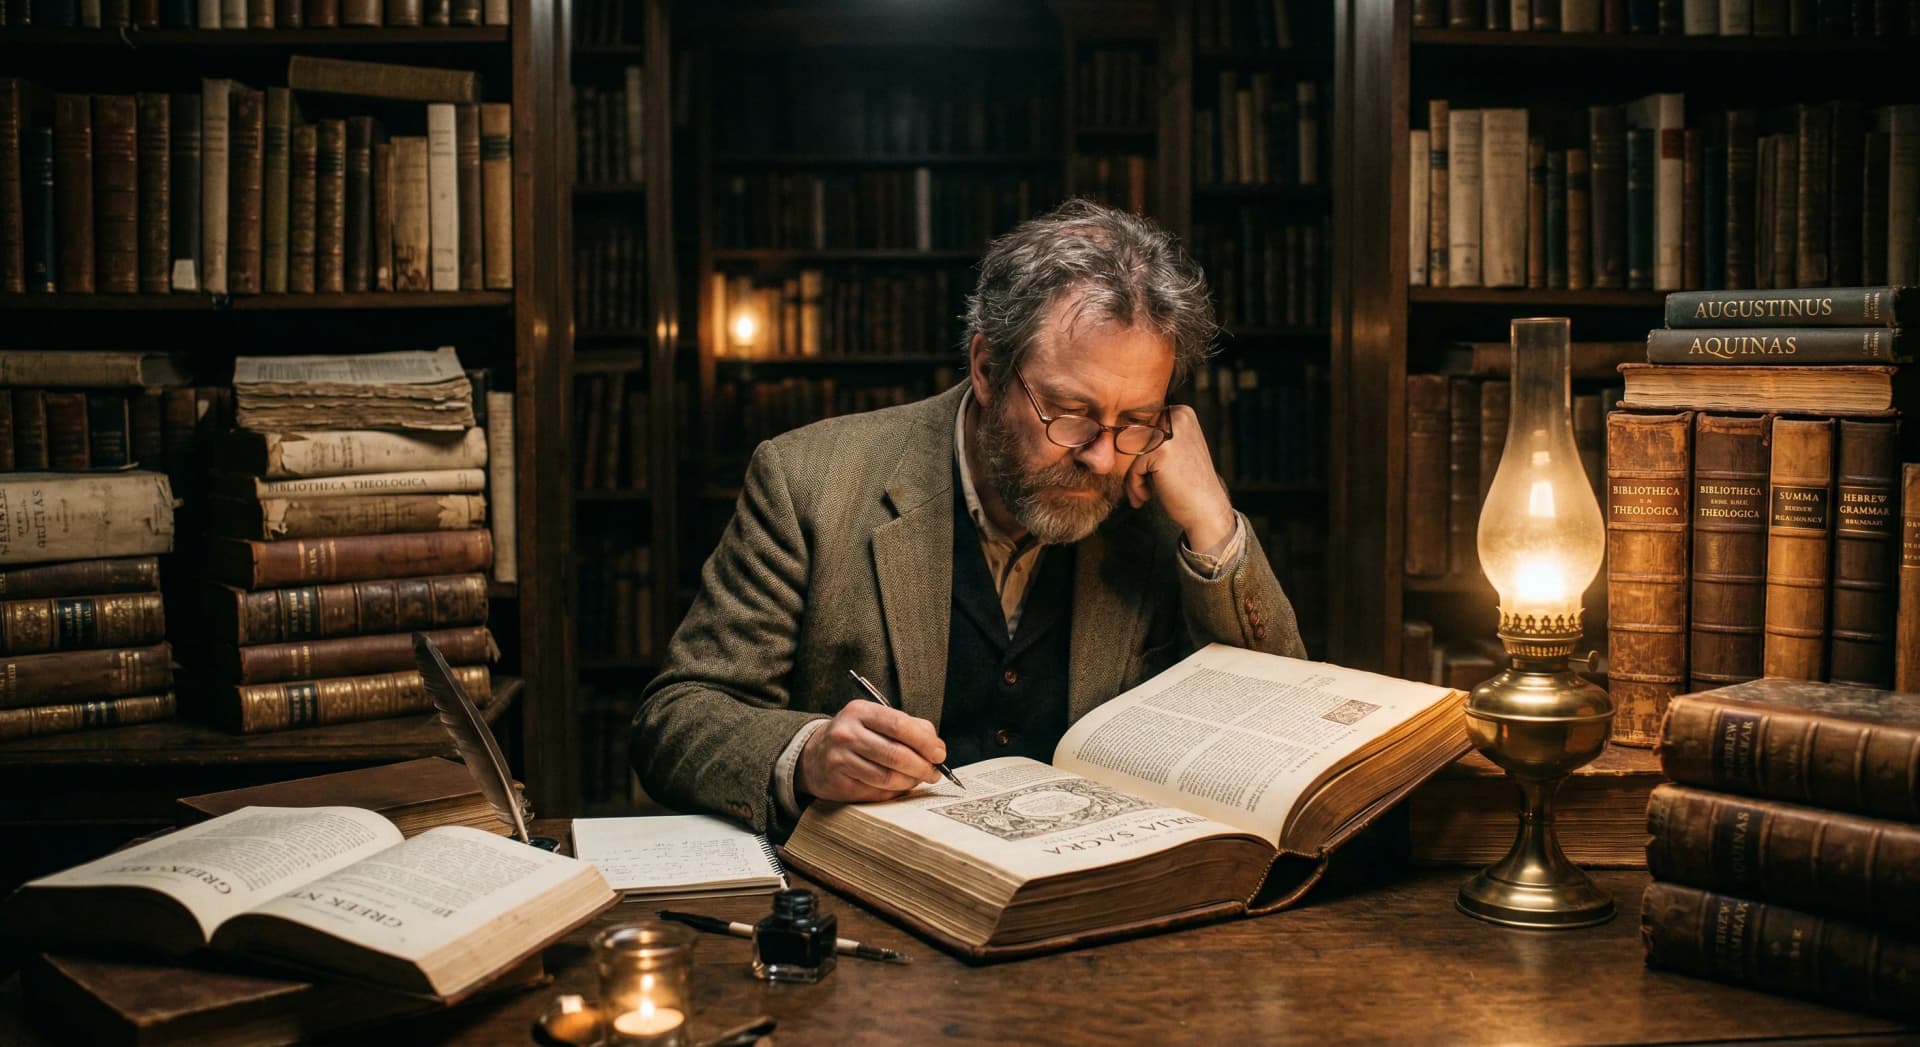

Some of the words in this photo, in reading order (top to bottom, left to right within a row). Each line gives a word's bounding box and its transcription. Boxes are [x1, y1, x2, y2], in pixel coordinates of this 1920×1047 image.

[1695, 298, 1832, 319] AUGUSTINUS
[1689, 336, 1797, 359] AQUINAS
[268, 480, 347, 493] BIBLIOTHECA
[352, 477, 428, 489] THEOLOGICA
[1612, 485, 1680, 496] BIBLIOTHECA
[1699, 485, 1762, 496] BIBLIOTHECA
[1779, 491, 1820, 502] SUMMA
[1843, 493, 1888, 504] HEBREW
[1613, 505, 1679, 516] THEOLOGICA
[1700, 508, 1760, 518] THEOLOGICA
[1839, 504, 1891, 516] GRAMMAR
[1042, 831, 1135, 855] SACRA
[331, 895, 403, 929] GREEK
